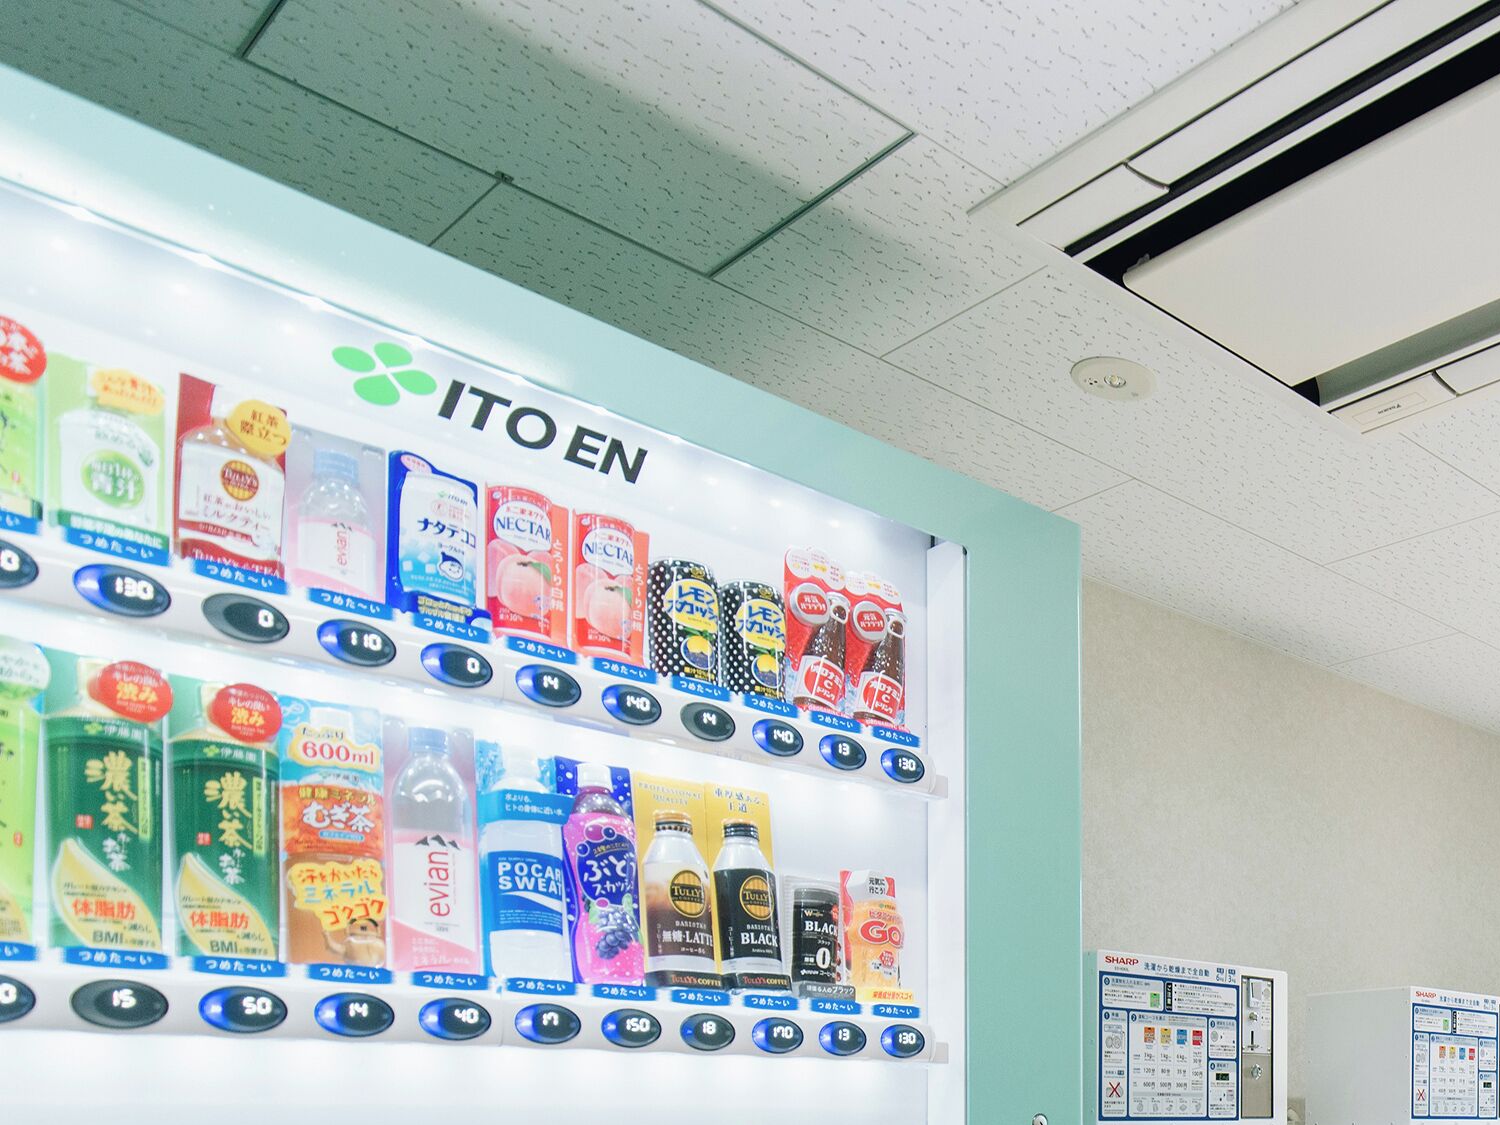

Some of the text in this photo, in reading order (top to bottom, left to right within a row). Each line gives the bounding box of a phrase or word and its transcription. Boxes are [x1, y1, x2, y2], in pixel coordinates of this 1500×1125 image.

[438, 379, 648, 484] ITO EN
[417, 517, 477, 549] ナタデココ
[496, 517, 551, 545] NECTAR
[80, 534, 154, 558] つめた～い
[337, 530, 349, 567] evian
[207, 565, 273, 587] つめた～い
[115, 577, 154, 600] 130
[678, 585, 715, 605] レモン
[321, 592, 381, 613] つめた～い
[259, 609, 274, 628] 0
[748, 605, 781, 625] レモン
[423, 618, 478, 637] つめた～い
[517, 641, 566, 659] つめた～い
[466, 657, 480, 674] 0
[602, 661, 647, 678] つめた～い
[680, 680, 722, 696] つめた～い
[824, 680, 833, 689] C
[626, 695, 651, 711] 140
[751, 698, 790, 712] つめた～い
[882, 695, 891, 703] C
[231, 707, 265, 726] 渋み
[818, 714, 854, 728] つめた～い
[773, 729, 794, 744] 140
[879, 729, 912, 743] つめた～い
[302, 741, 375, 765] 600ml
[838, 743, 850, 756] 13
[899, 757, 916, 771] 130
[303, 801, 374, 832] むぎ茶
[299, 866, 378, 884] 汗をかいたら
[869, 877, 885, 886] 元気に
[424, 850, 451, 917] evian
[499, 878, 562, 895] SWEAT
[869, 887, 886, 895] 行こう!
[304, 881, 376, 904] ミネラル
[72, 899, 136, 920] 体脂肪
[323, 897, 385, 926] ゴクゴク
[190, 911, 249, 929] 体脂肪
[92, 931, 123, 944] BMI
[740, 932, 779, 947] BLACK
[861, 920, 902, 947] GO
[210, 940, 238, 953] BMI
[79, 952, 152, 964] つめた～い
[206, 960, 272, 972] つめた～い
[816, 948, 831, 969] 0
[1104, 955, 1139, 966] SHARP
[320, 968, 379, 980] つめた～い
[1144, 962, 1210, 977] 洗濯から乾燥まで全自動
[423, 974, 477, 986] つめた～い
[516, 981, 566, 991] つめた～い
[112, 989, 136, 1008] 15
[602, 987, 647, 997] つめた～い
[680, 993, 721, 1002] つめた～い
[1416, 991, 1436, 999] SHARP
[243, 996, 272, 1014] 50
[751, 997, 790, 1007] つめた～い
[818, 1003, 854, 1011] つめた～い
[454, 1008, 479, 1024] 40
[879, 1007, 912, 1015] つめた～い
[626, 1018, 650, 1032] 150
[703, 1021, 716, 1034] 18
[773, 1026, 793, 1039] 170
[839, 1028, 849, 1041] 13
[899, 1032, 916, 1044] 130
